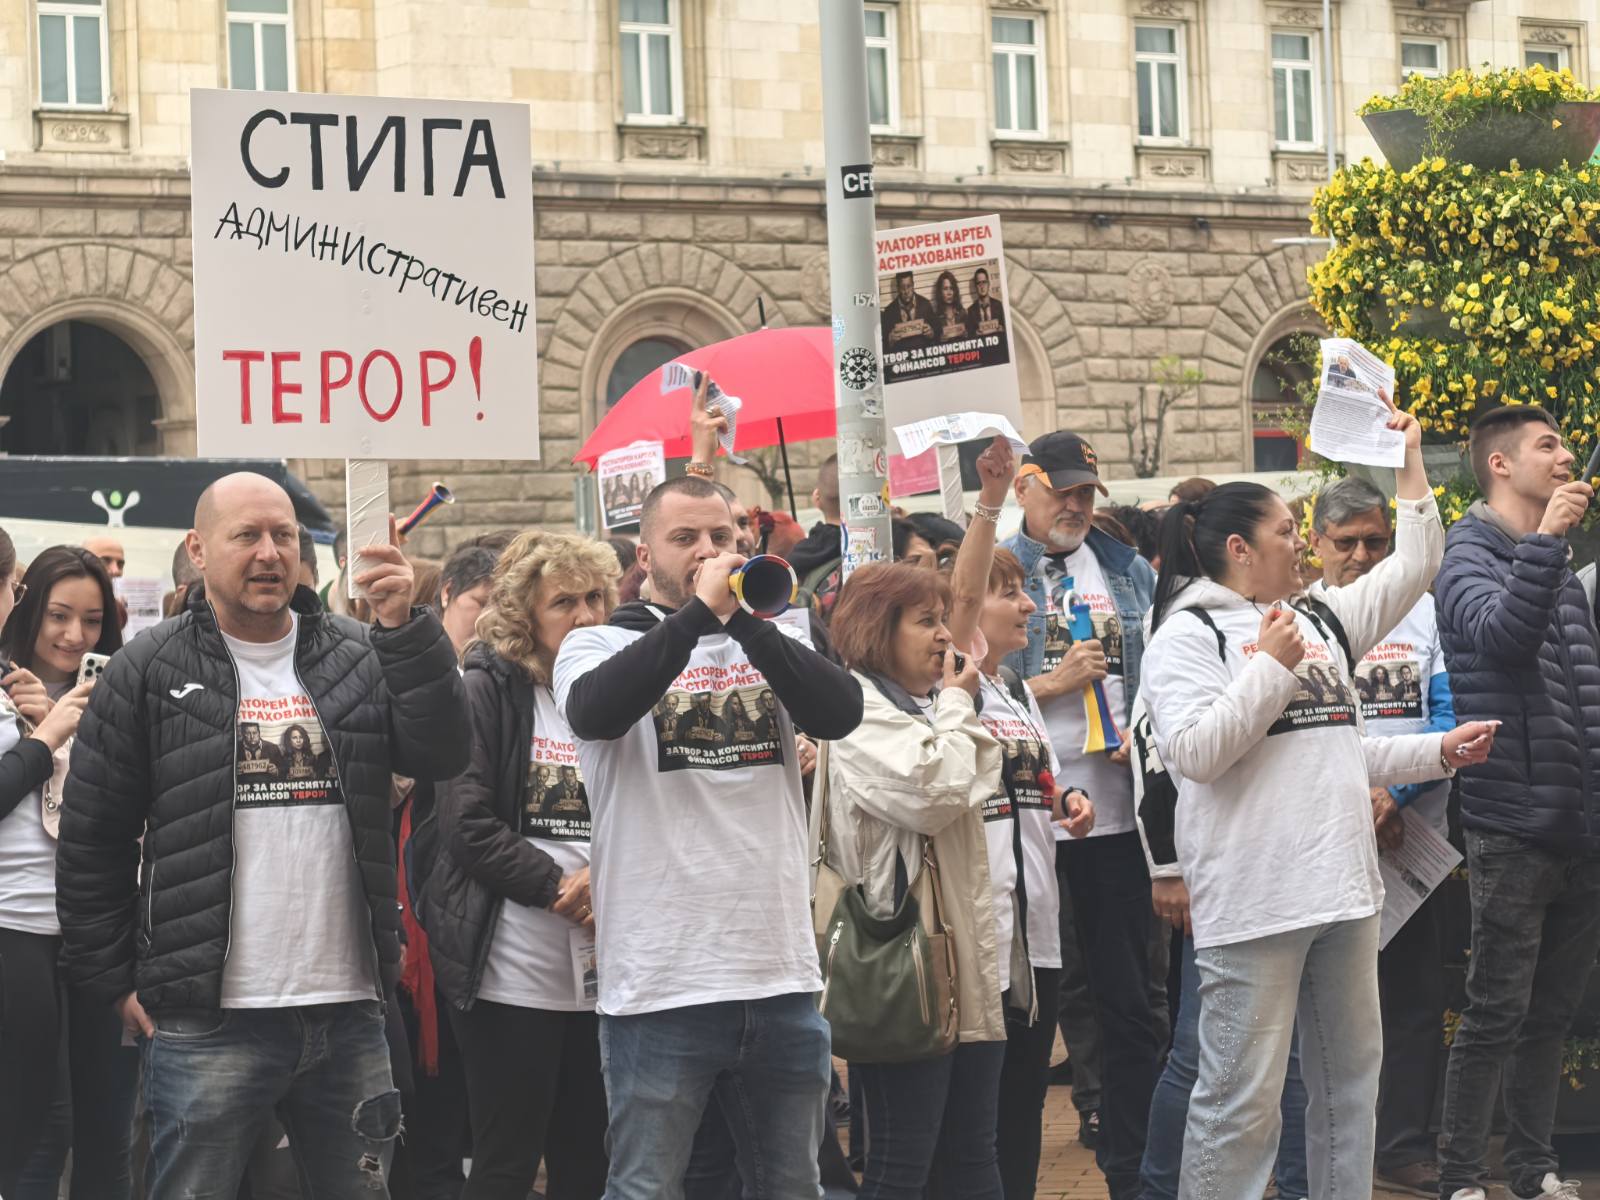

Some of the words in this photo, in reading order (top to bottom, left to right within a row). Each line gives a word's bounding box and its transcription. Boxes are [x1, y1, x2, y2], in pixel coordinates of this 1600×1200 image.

[241, 109, 506, 198] СТИГА
[944, 225, 992, 244] КАРТЕЛ
[879, 244, 984, 271] АСТРАХОВАНЕТО
[884, 351, 908, 364] ТВОР
[911, 349, 924, 359] ЗА
[926, 340, 984, 356] КОМИСИЯТА
[986, 336, 998, 347] ПО
[892, 356, 946, 374] ФИНАНСОВ
[948, 351, 980, 364] ТЕРОР!
[222, 336, 484, 426] ТЕРОР!
[1292, 714, 1328, 725] ФИНАНСОВ
[536, 750, 542, 759] В
[666, 746, 702, 755] ЗАТВОР
[703, 749, 715, 757] ЗА
[717, 741, 776, 756] КОМИСИЯТА
[688, 754, 739, 764] ФИНАНСОВ
[253, 784, 267, 792] ЗА
[270, 780, 332, 790] КОМИСИЯТА
[238, 792, 290, 802] ИНАНСОВ
[530, 817, 567, 827] ЗАТВОР
[569, 820, 579, 828] ЗА
